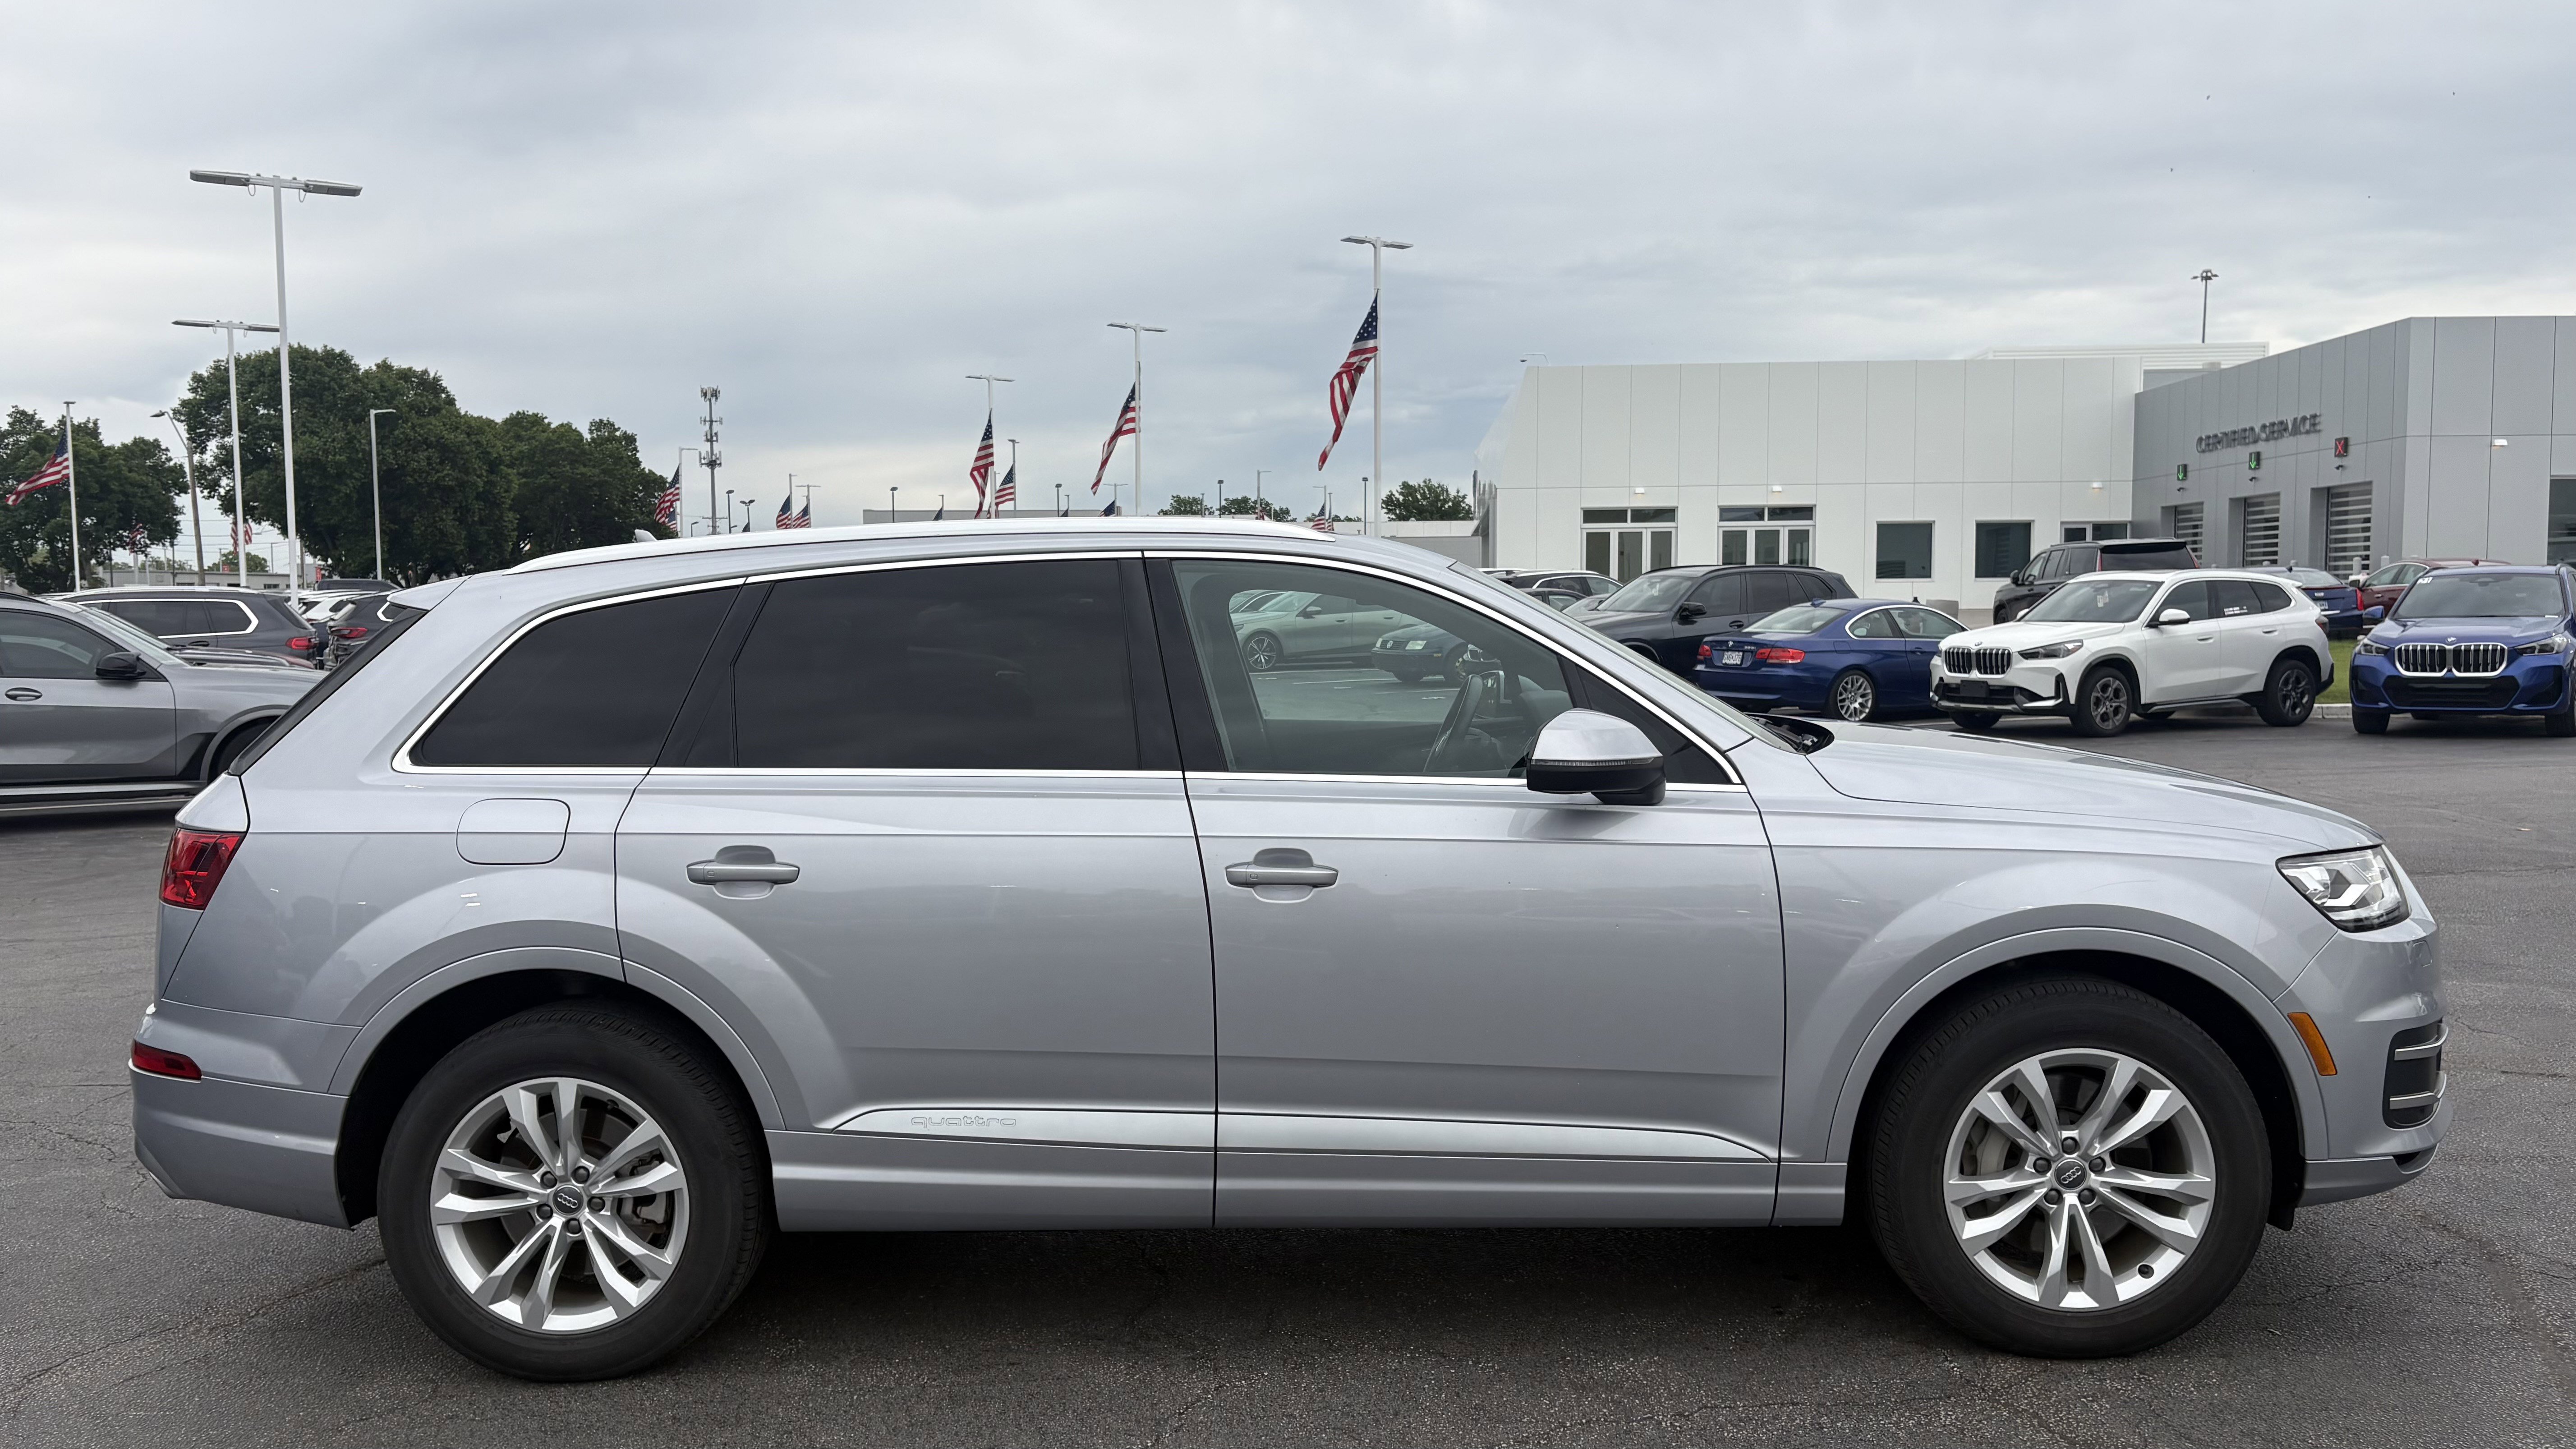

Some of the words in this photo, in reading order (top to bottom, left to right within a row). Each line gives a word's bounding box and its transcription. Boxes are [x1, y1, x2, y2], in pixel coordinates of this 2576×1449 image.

[2196, 425, 2259, 453] CERTIFIED
[2259, 412, 2322, 442] SERVICE
[911, 1116, 1017, 1128] quattro
